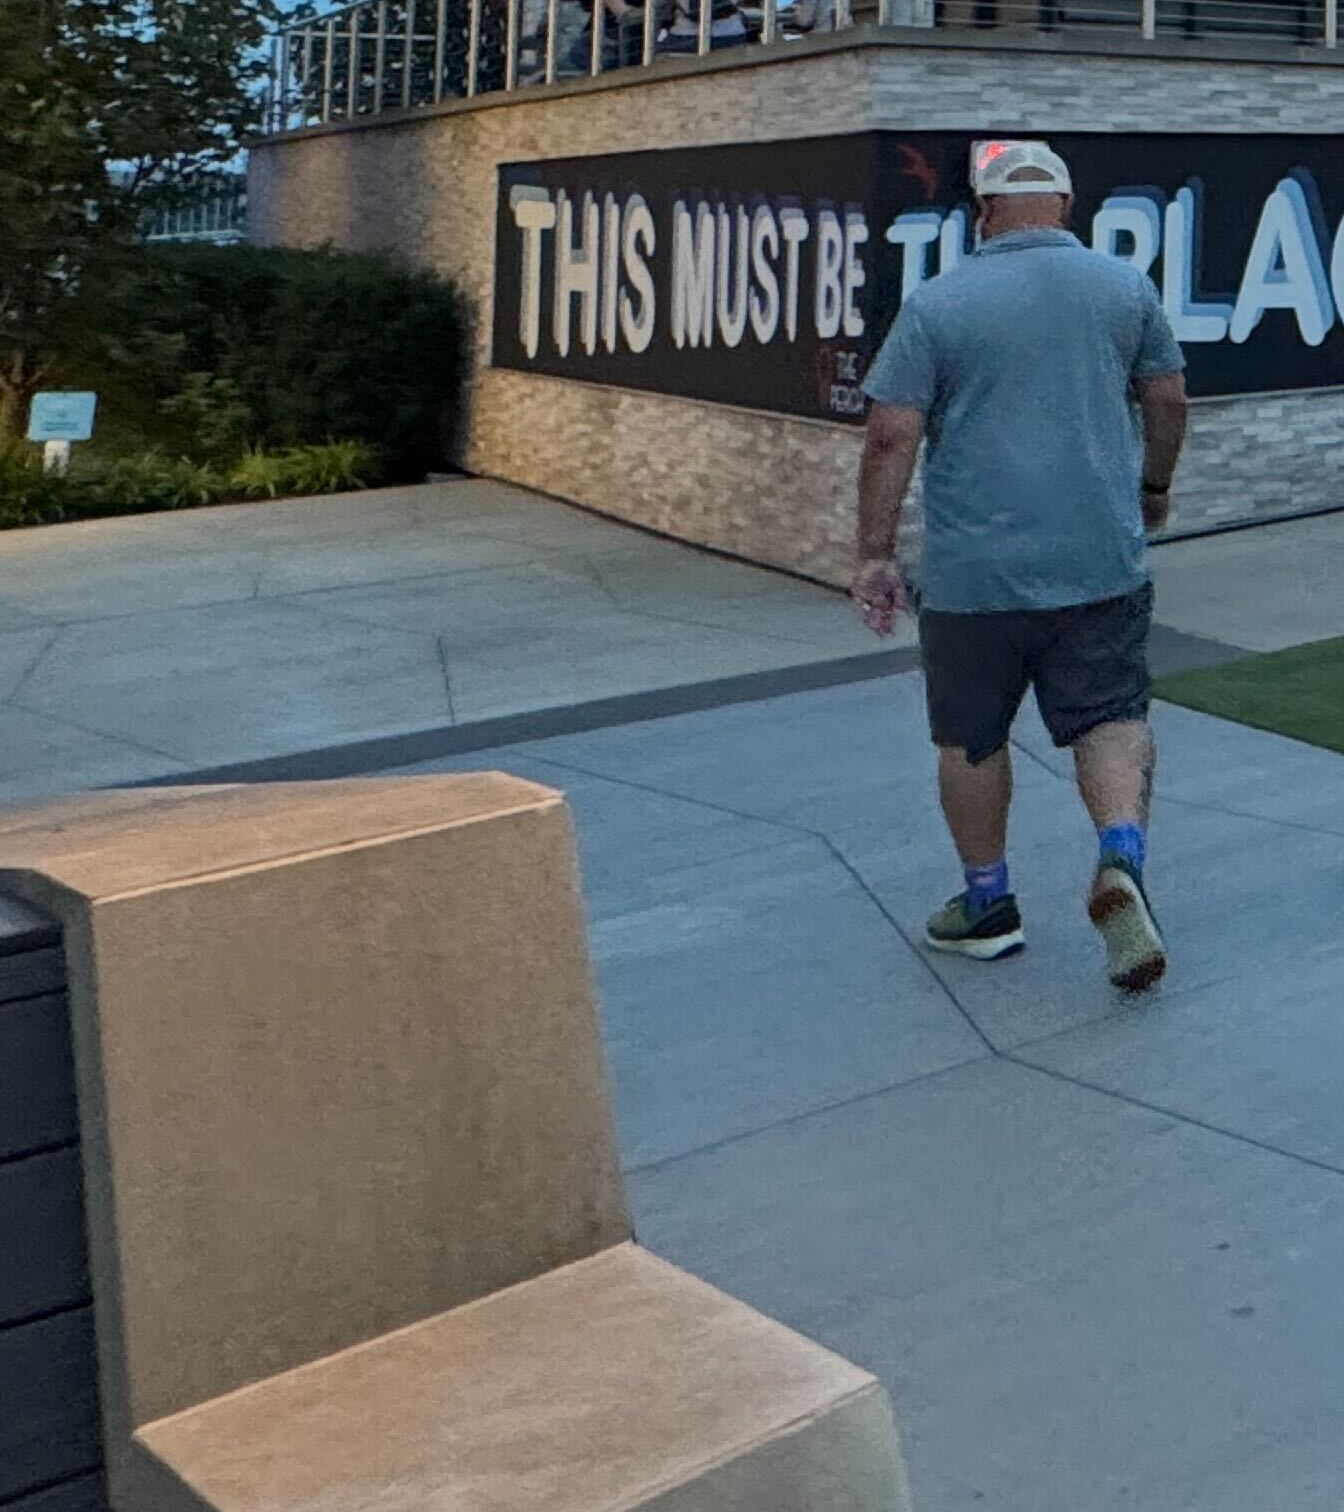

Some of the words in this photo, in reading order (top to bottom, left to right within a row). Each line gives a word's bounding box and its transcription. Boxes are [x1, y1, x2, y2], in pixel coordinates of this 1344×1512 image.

[509, 185, 657, 360] THIS
[670, 199, 809, 350] MUST
[814, 205, 869, 339] BE
